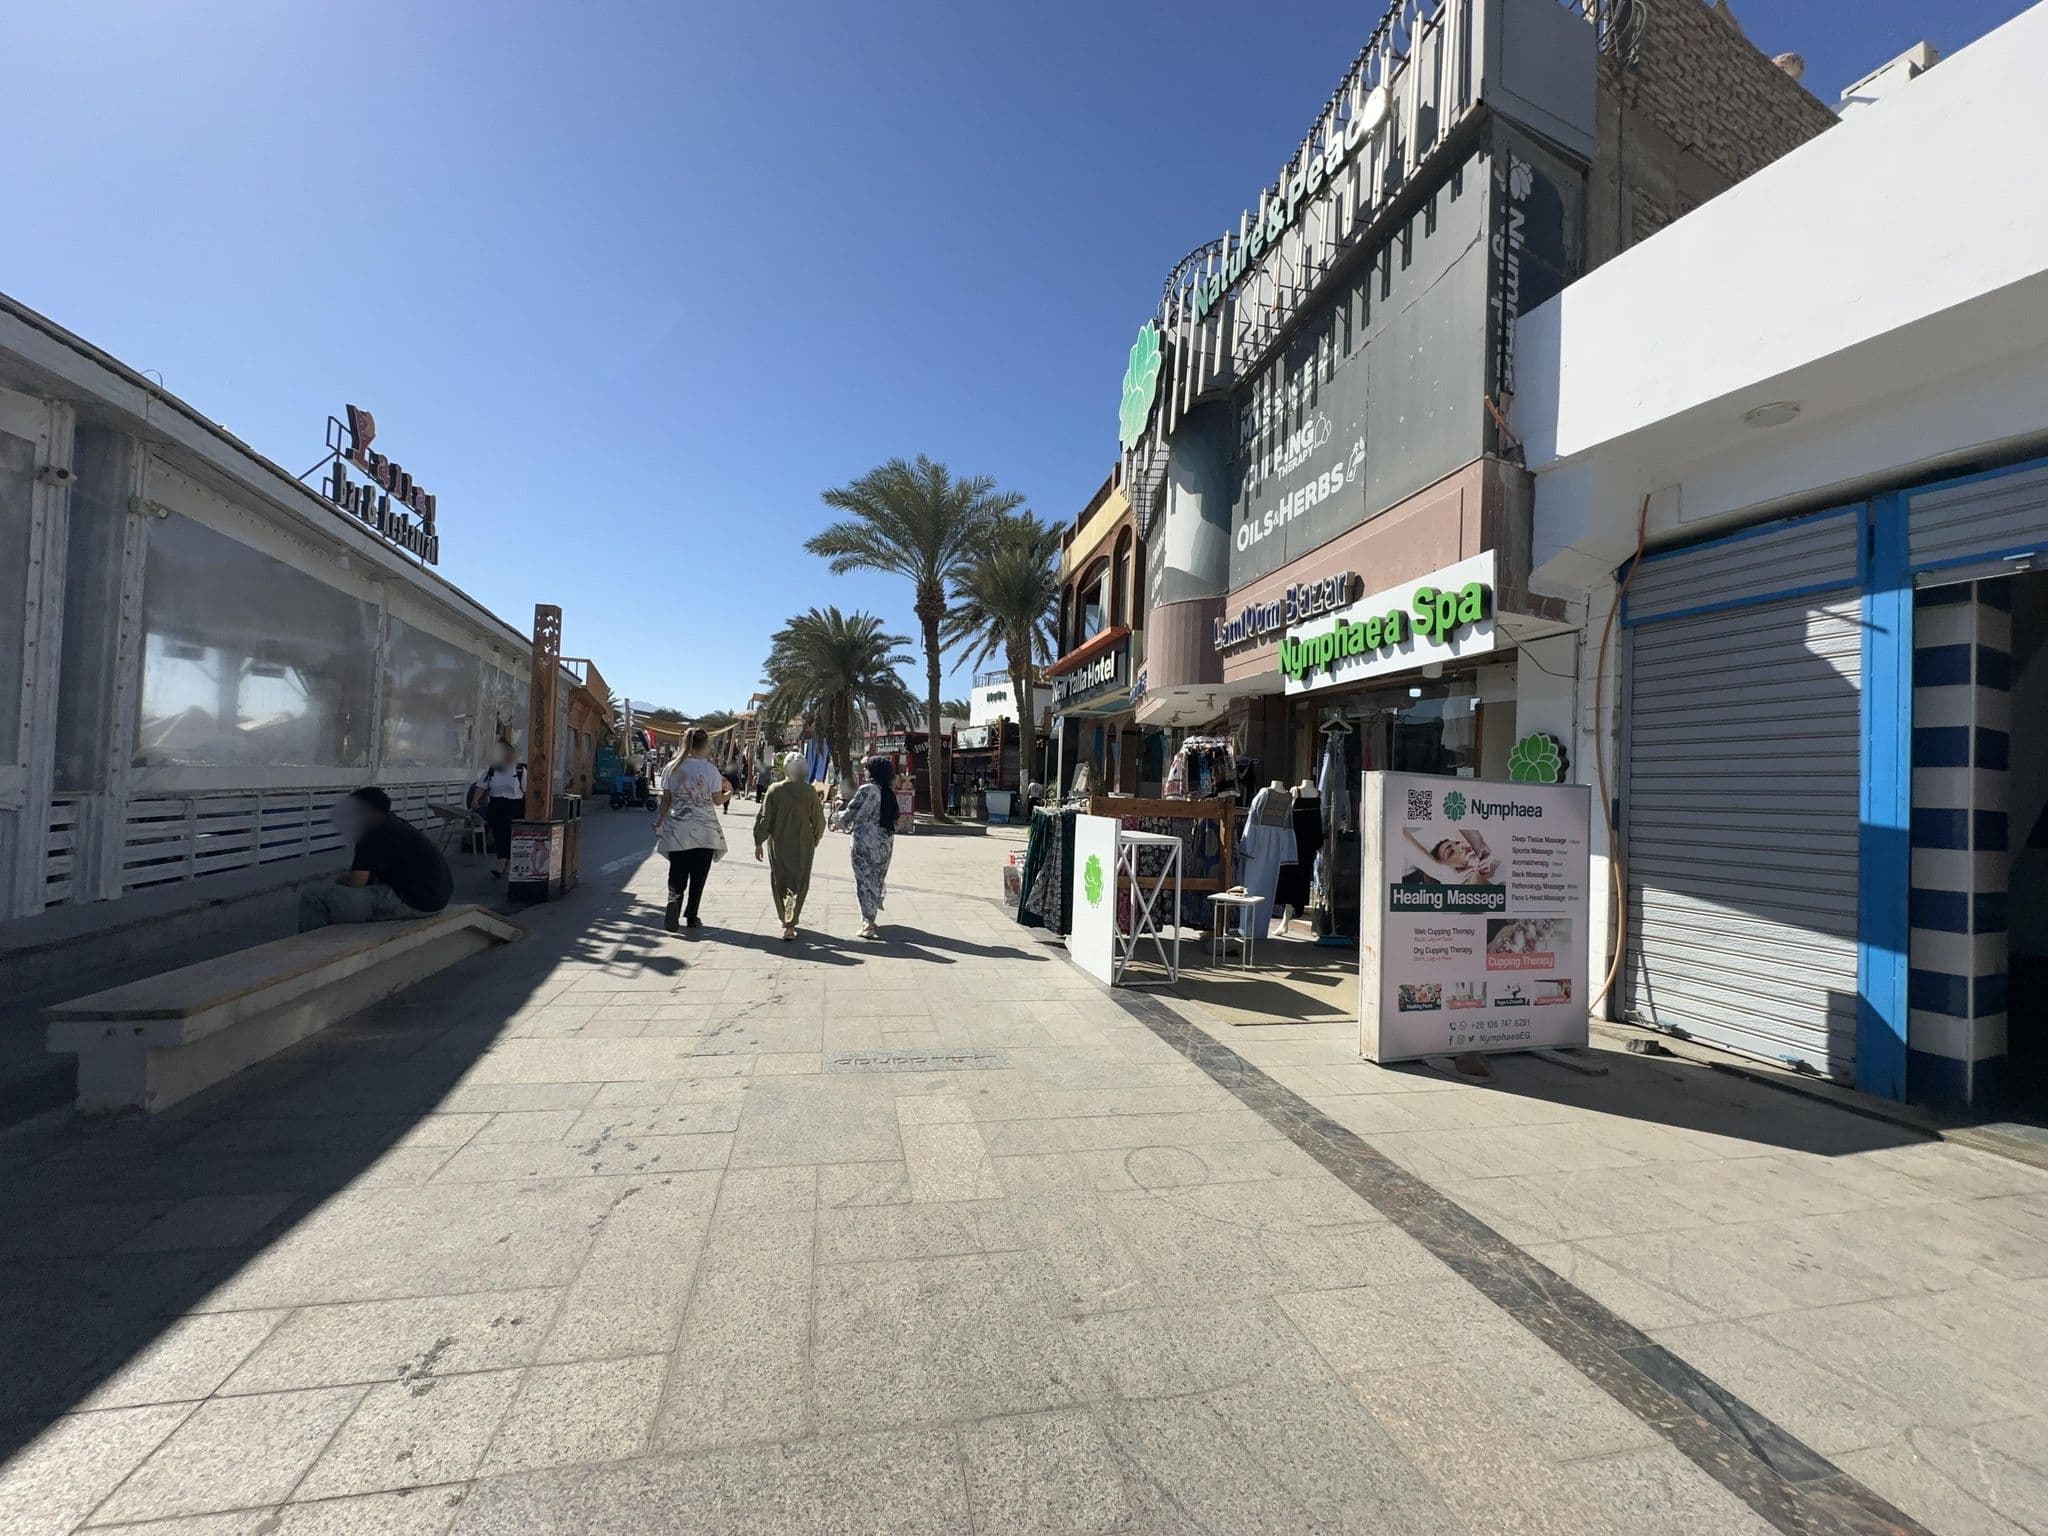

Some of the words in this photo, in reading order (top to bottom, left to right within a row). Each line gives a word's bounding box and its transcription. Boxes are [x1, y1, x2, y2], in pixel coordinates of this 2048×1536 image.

[1277, 444, 1313, 482] THERAPY
[1286, 570, 1348, 625] Bazar
[1278, 609, 1400, 680] Nymphaea
[1411, 582, 1482, 645] Spa
[1088, 650, 1115, 688] Hotel
[1471, 799, 1543, 821] Nymphaea
[1545, 837, 1566, 845] Massage
[1543, 883, 1565, 891] Massage
[1393, 889, 1443, 909] Healing
[1447, 890, 1504, 909] Massage
[1428, 928, 1451, 936] Cupping
[1452, 928, 1475, 936] Therapy
[1413, 947, 1424, 955] Dry
[1425, 947, 1449, 955] Cupping
[1450, 946, 1473, 955] Therapy
[1489, 957, 1520, 968] Cupping
[1523, 956, 1553, 967] Therapy
[1480, 1031, 1531, 1044] NymphaeaEG
